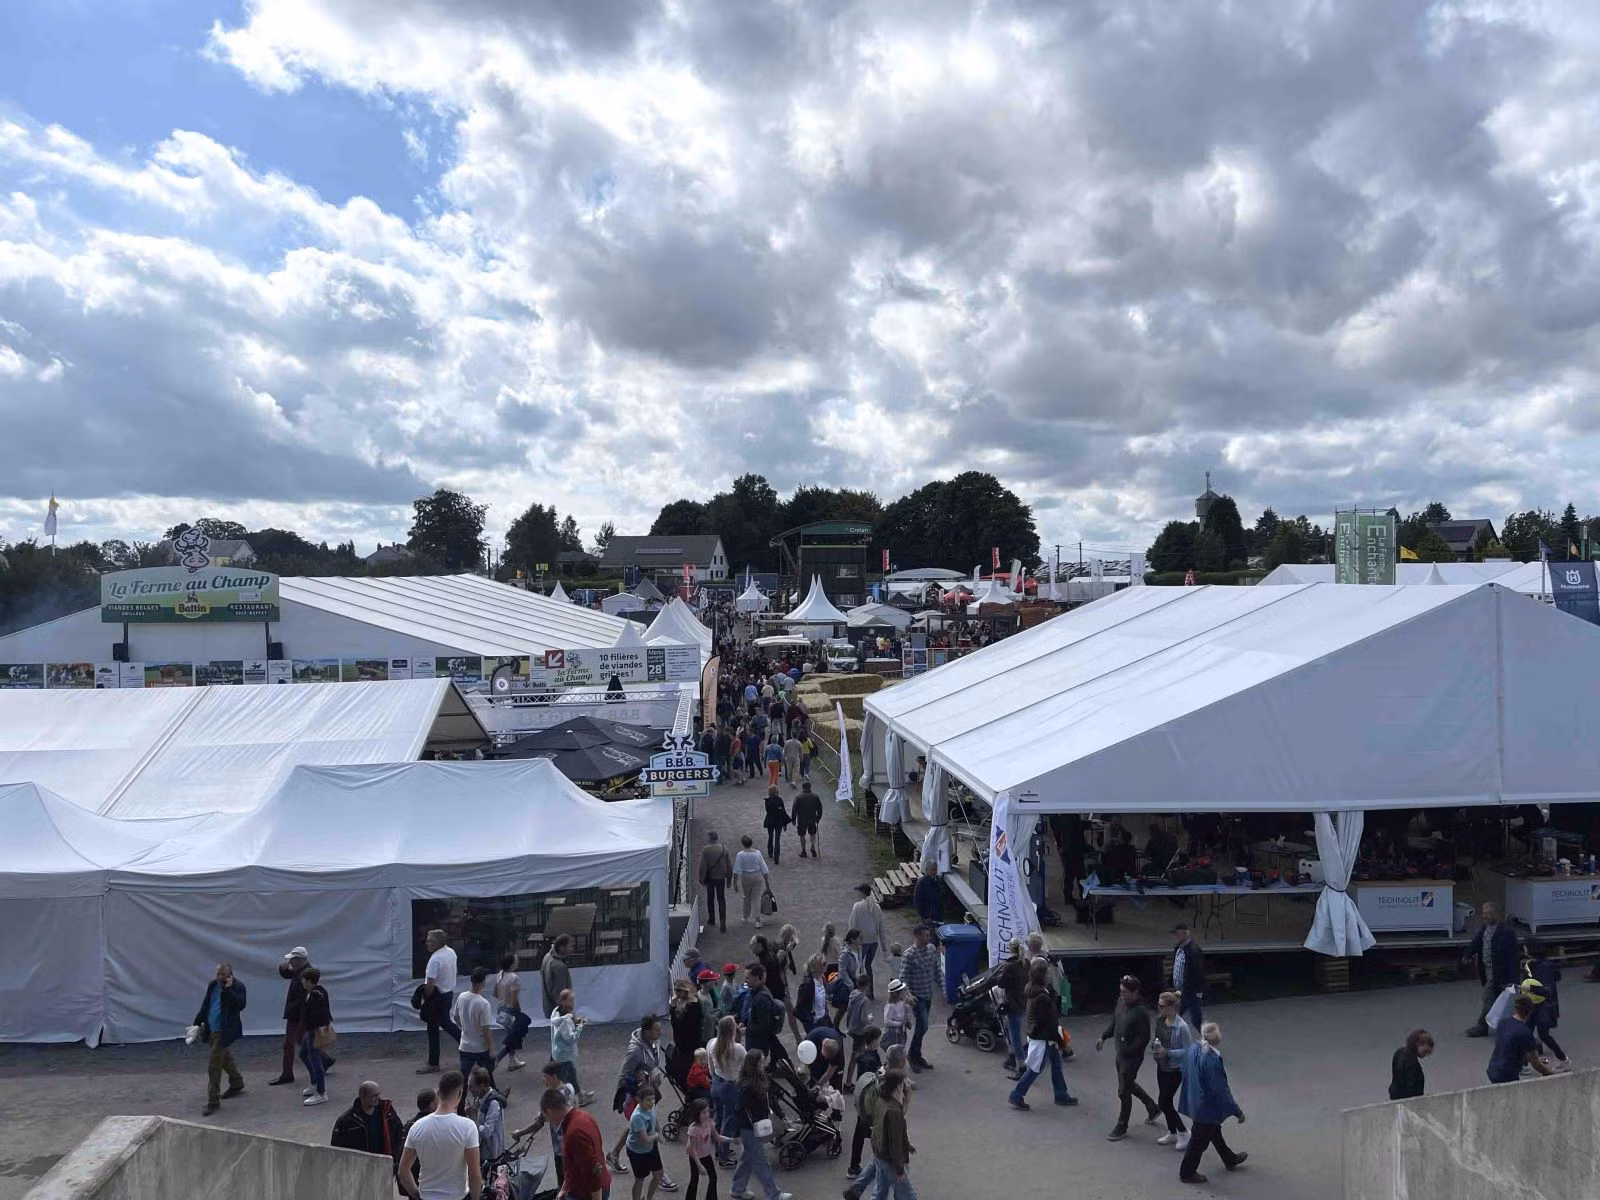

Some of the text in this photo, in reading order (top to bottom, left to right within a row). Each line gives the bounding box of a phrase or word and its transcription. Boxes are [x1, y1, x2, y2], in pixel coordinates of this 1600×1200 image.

[1378, 548, 1387, 573] Ferme
[109, 575, 270, 599] La Ferme au Champ
[178, 604, 206, 612] Battin
[612, 661, 643, 670] viandes
[566, 673, 593, 681] Champ
[665, 757, 696, 768] B.B.B.
[650, 769, 710, 781] BURGERS
[995, 866, 1013, 964] TECHNOLIT
